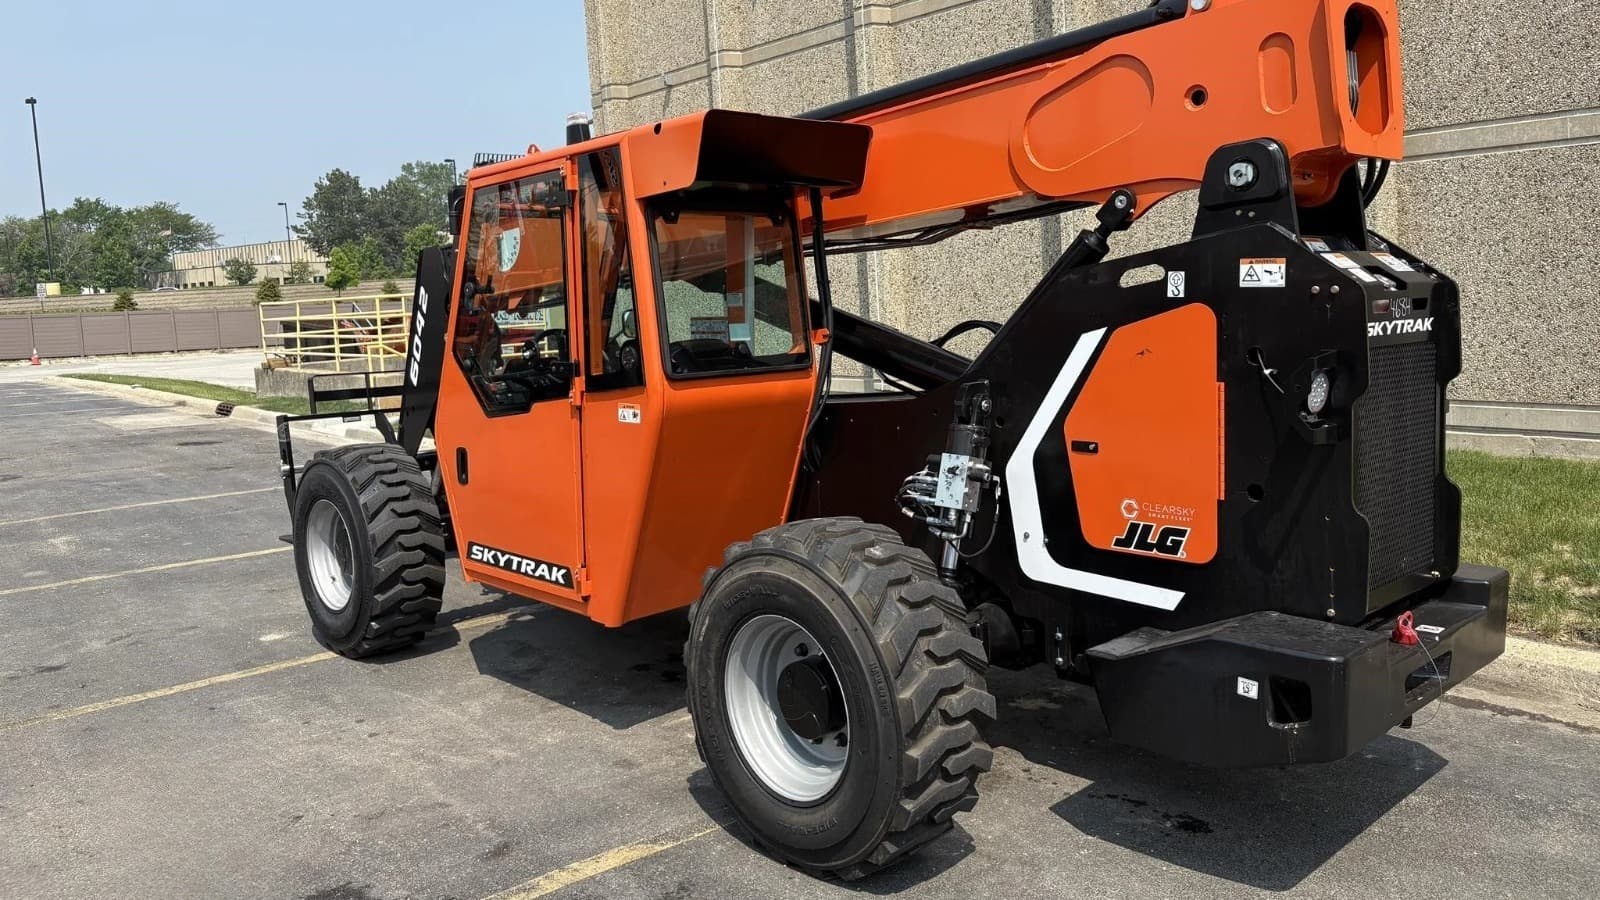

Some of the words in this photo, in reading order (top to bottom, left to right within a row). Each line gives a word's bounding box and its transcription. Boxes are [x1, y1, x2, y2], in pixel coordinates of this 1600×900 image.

[1390, 297, 1411, 318] 4684
[410, 285, 429, 387] 6042
[1368, 317, 1434, 337] SKYTRAK
[1142, 502, 1195, 516] CLEARSKY
[1111, 520, 1191, 558] JLG
[470, 545, 568, 584] SKYTRAK
